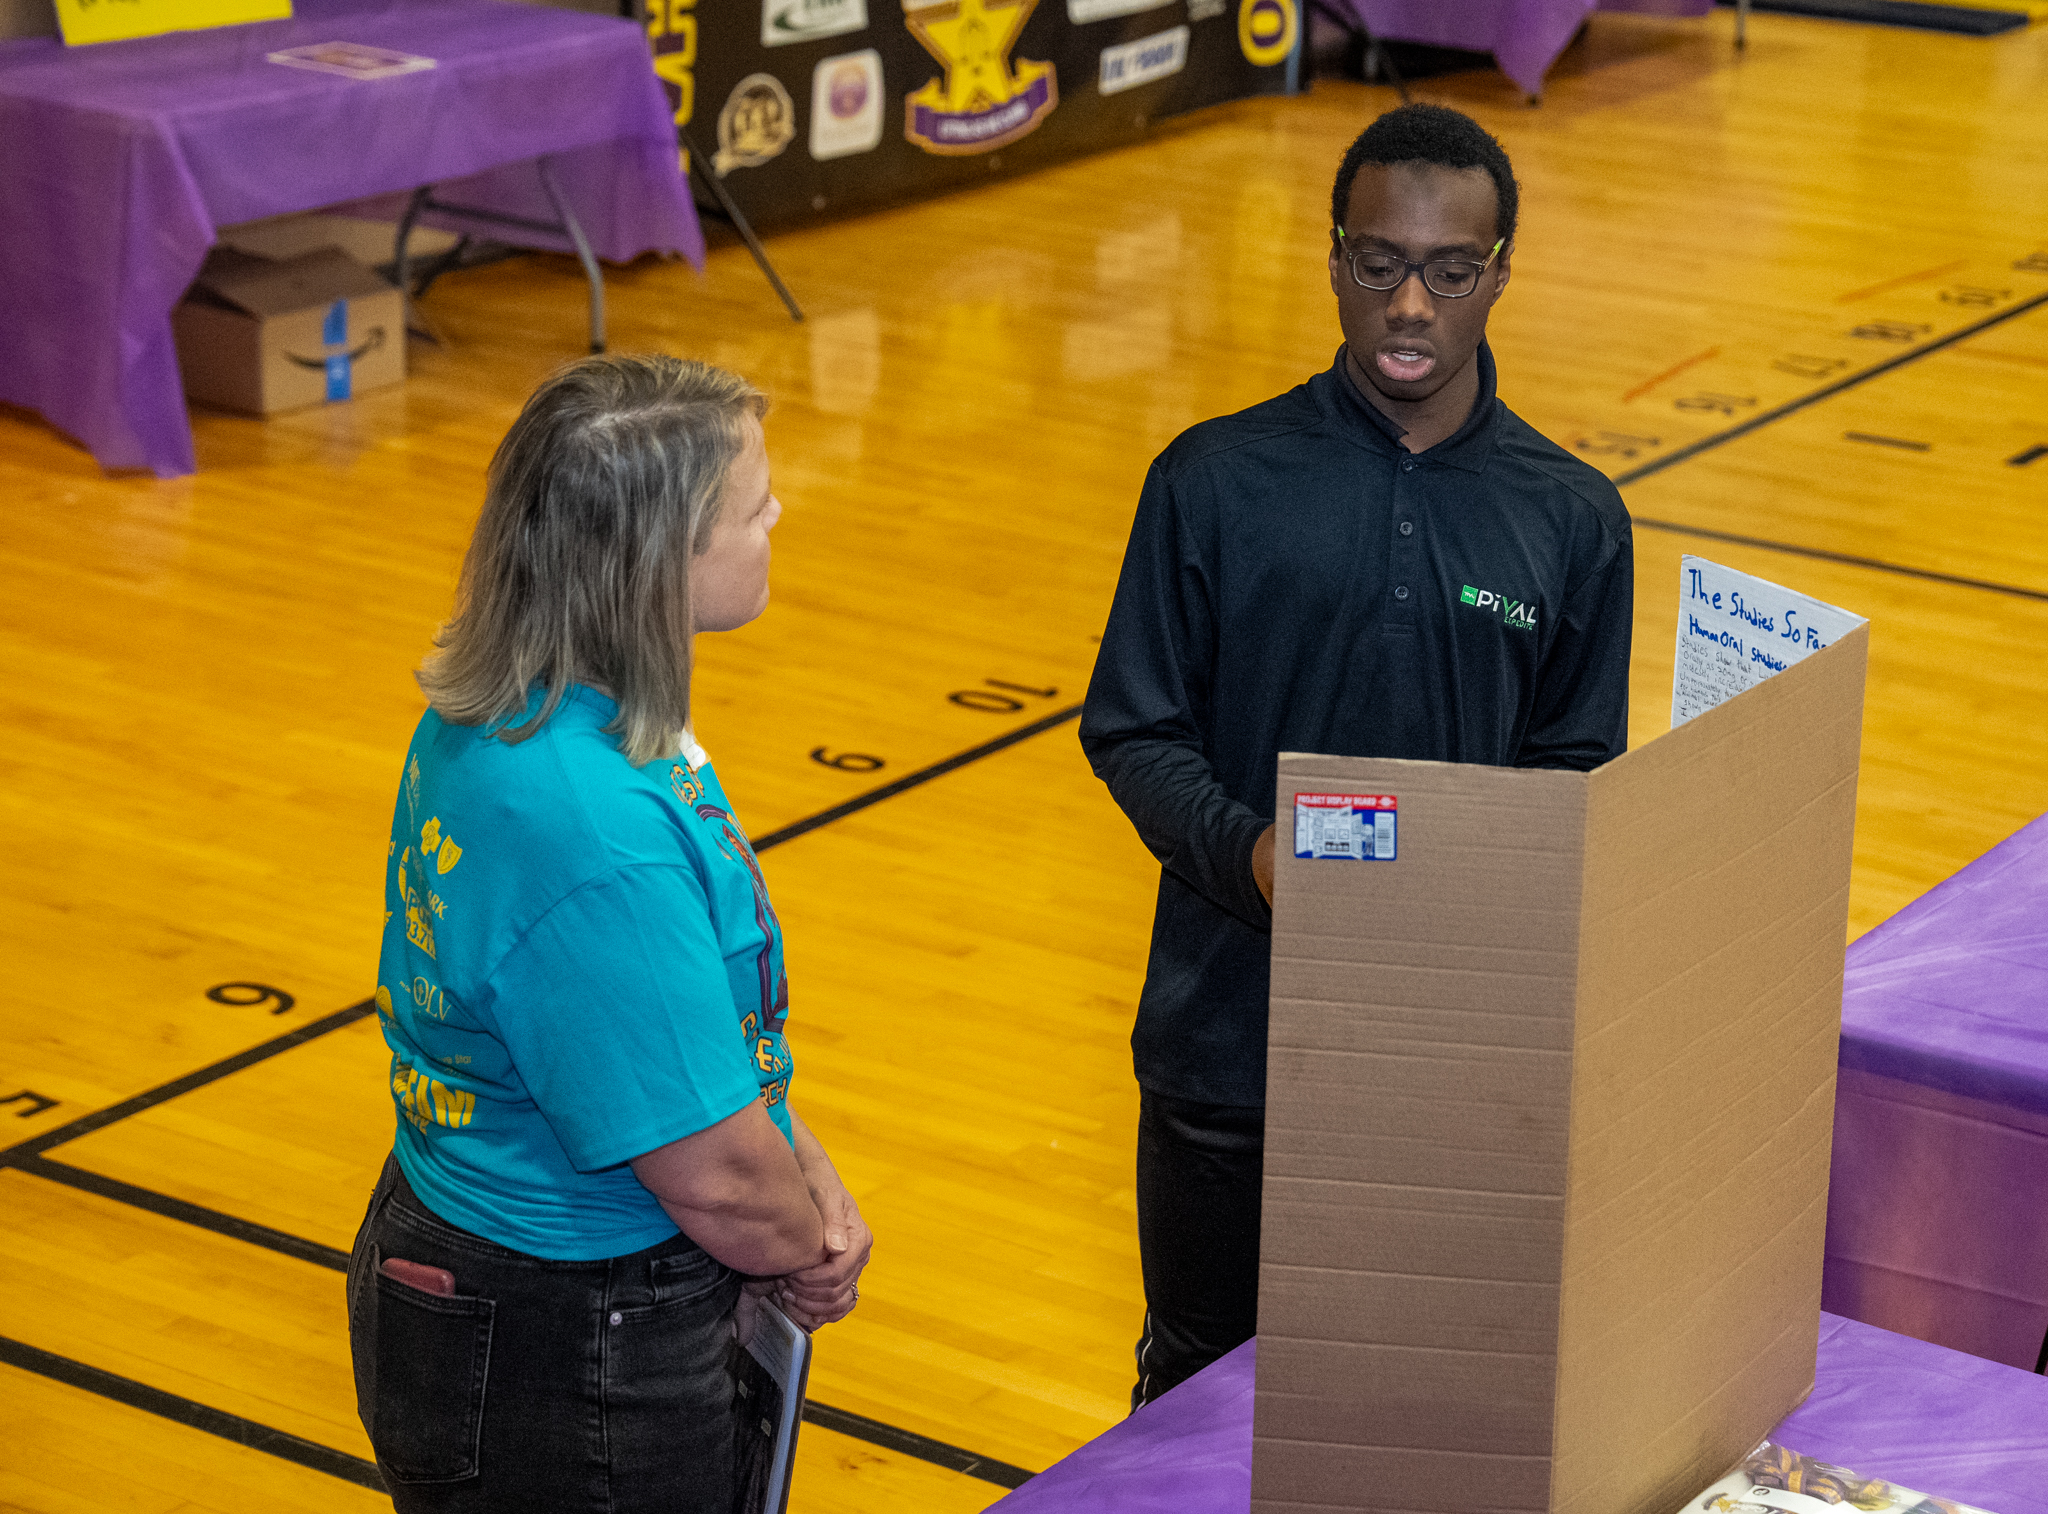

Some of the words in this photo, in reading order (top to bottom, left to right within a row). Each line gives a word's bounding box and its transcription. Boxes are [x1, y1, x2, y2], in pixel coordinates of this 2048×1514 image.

[1689, 569, 1722, 609] The
[1730, 592, 1774, 632] Studies
[1781, 610, 1801, 643] So
[1720, 631, 1743, 656] Oral
[947, 678, 1059, 715] 10
[1297, 795, 1325, 804] PROJECT
[1326, 796, 1352, 805] DISPLAY
[1353, 797, 1377, 806] BOARD
[413, 976, 451, 1021] OLV
